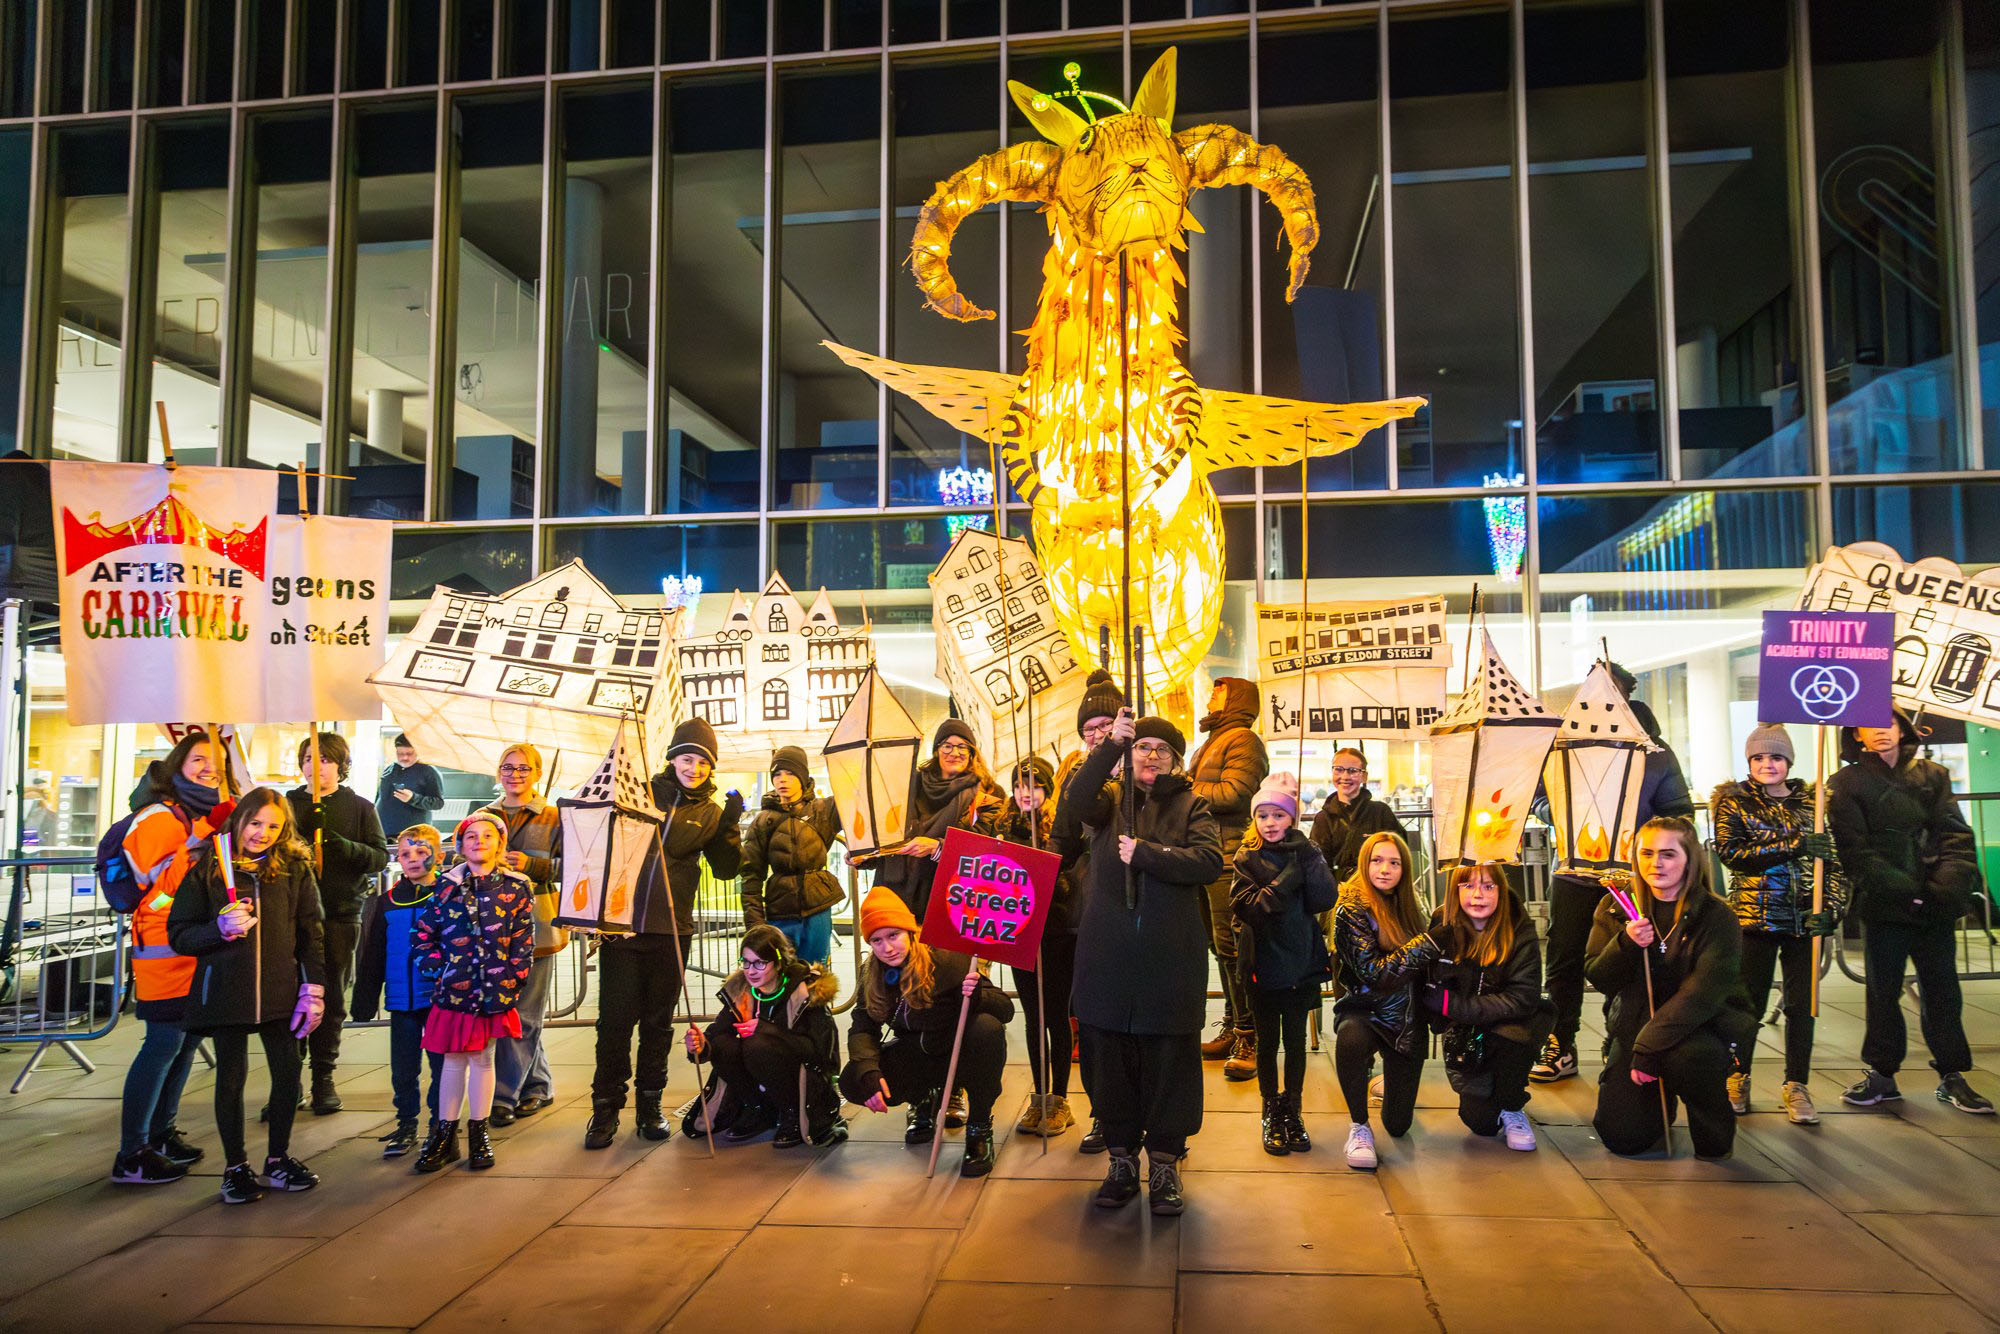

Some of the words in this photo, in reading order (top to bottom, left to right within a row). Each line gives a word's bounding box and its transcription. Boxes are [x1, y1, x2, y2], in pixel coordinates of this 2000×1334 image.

[90, 561, 185, 584] AFTER
[193, 565, 243, 588] THE
[81, 589, 249, 642] CARNIVAL
[304, 623, 370, 646] Street
[1788, 619, 1867, 644] TRINITY
[1274, 661, 1292, 672] THE
[1293, 653, 1330, 669] BAST
[1344, 649, 1382, 663] ELDON
[1387, 647, 1431, 659] STREET
[1766, 644, 1816, 658] ACADEMY
[1817, 645, 1832, 659] ST
[1835, 646, 1890, 661] EDWARDS
[958, 855, 1028, 886] Eldon
[947, 884, 1031, 916] Street
[960, 915, 1018, 944] HAZ
